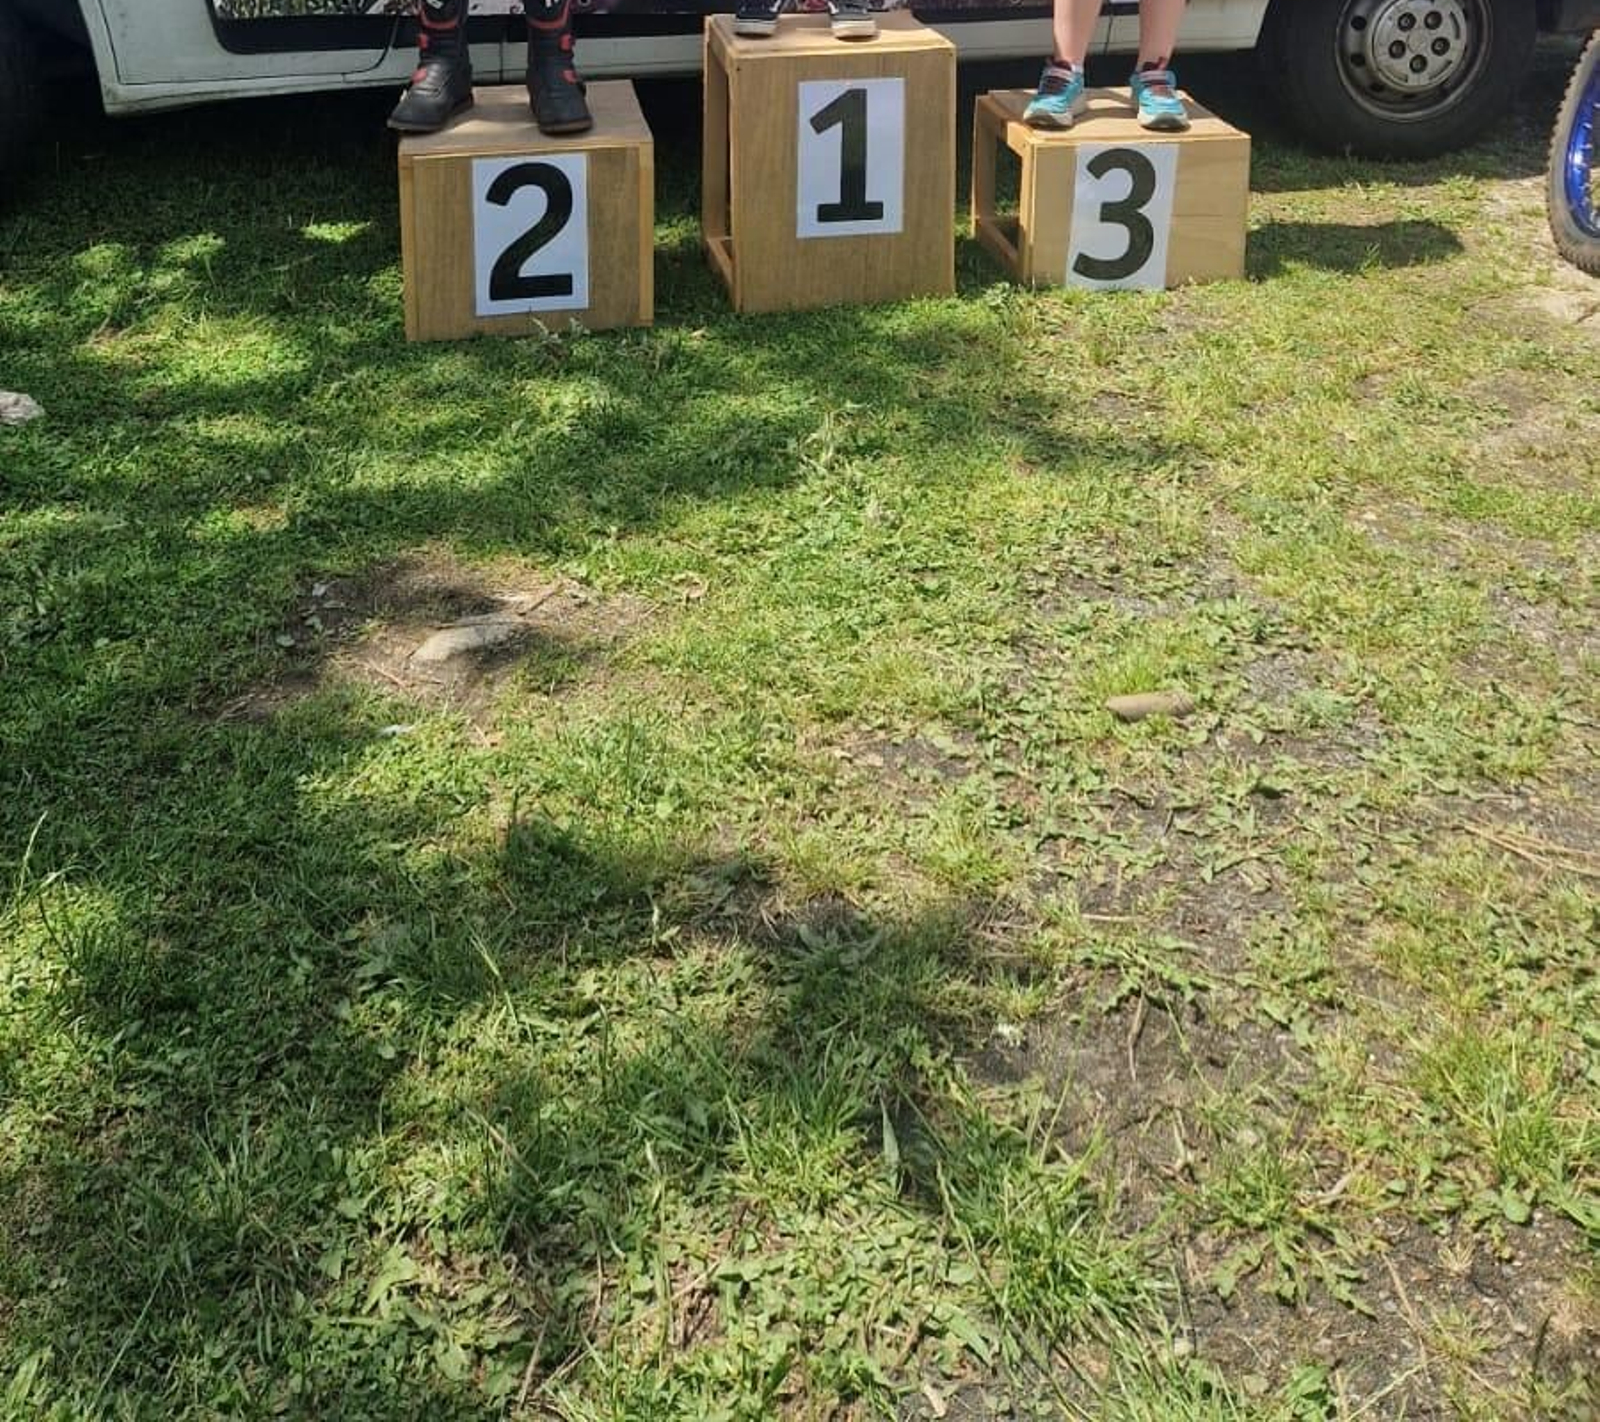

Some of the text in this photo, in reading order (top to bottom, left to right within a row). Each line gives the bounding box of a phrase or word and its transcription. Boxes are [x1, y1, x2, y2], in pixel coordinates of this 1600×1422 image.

[810, 88, 884, 223] 1
[1073, 148, 1157, 281] 3
[486, 162, 574, 302] 2
